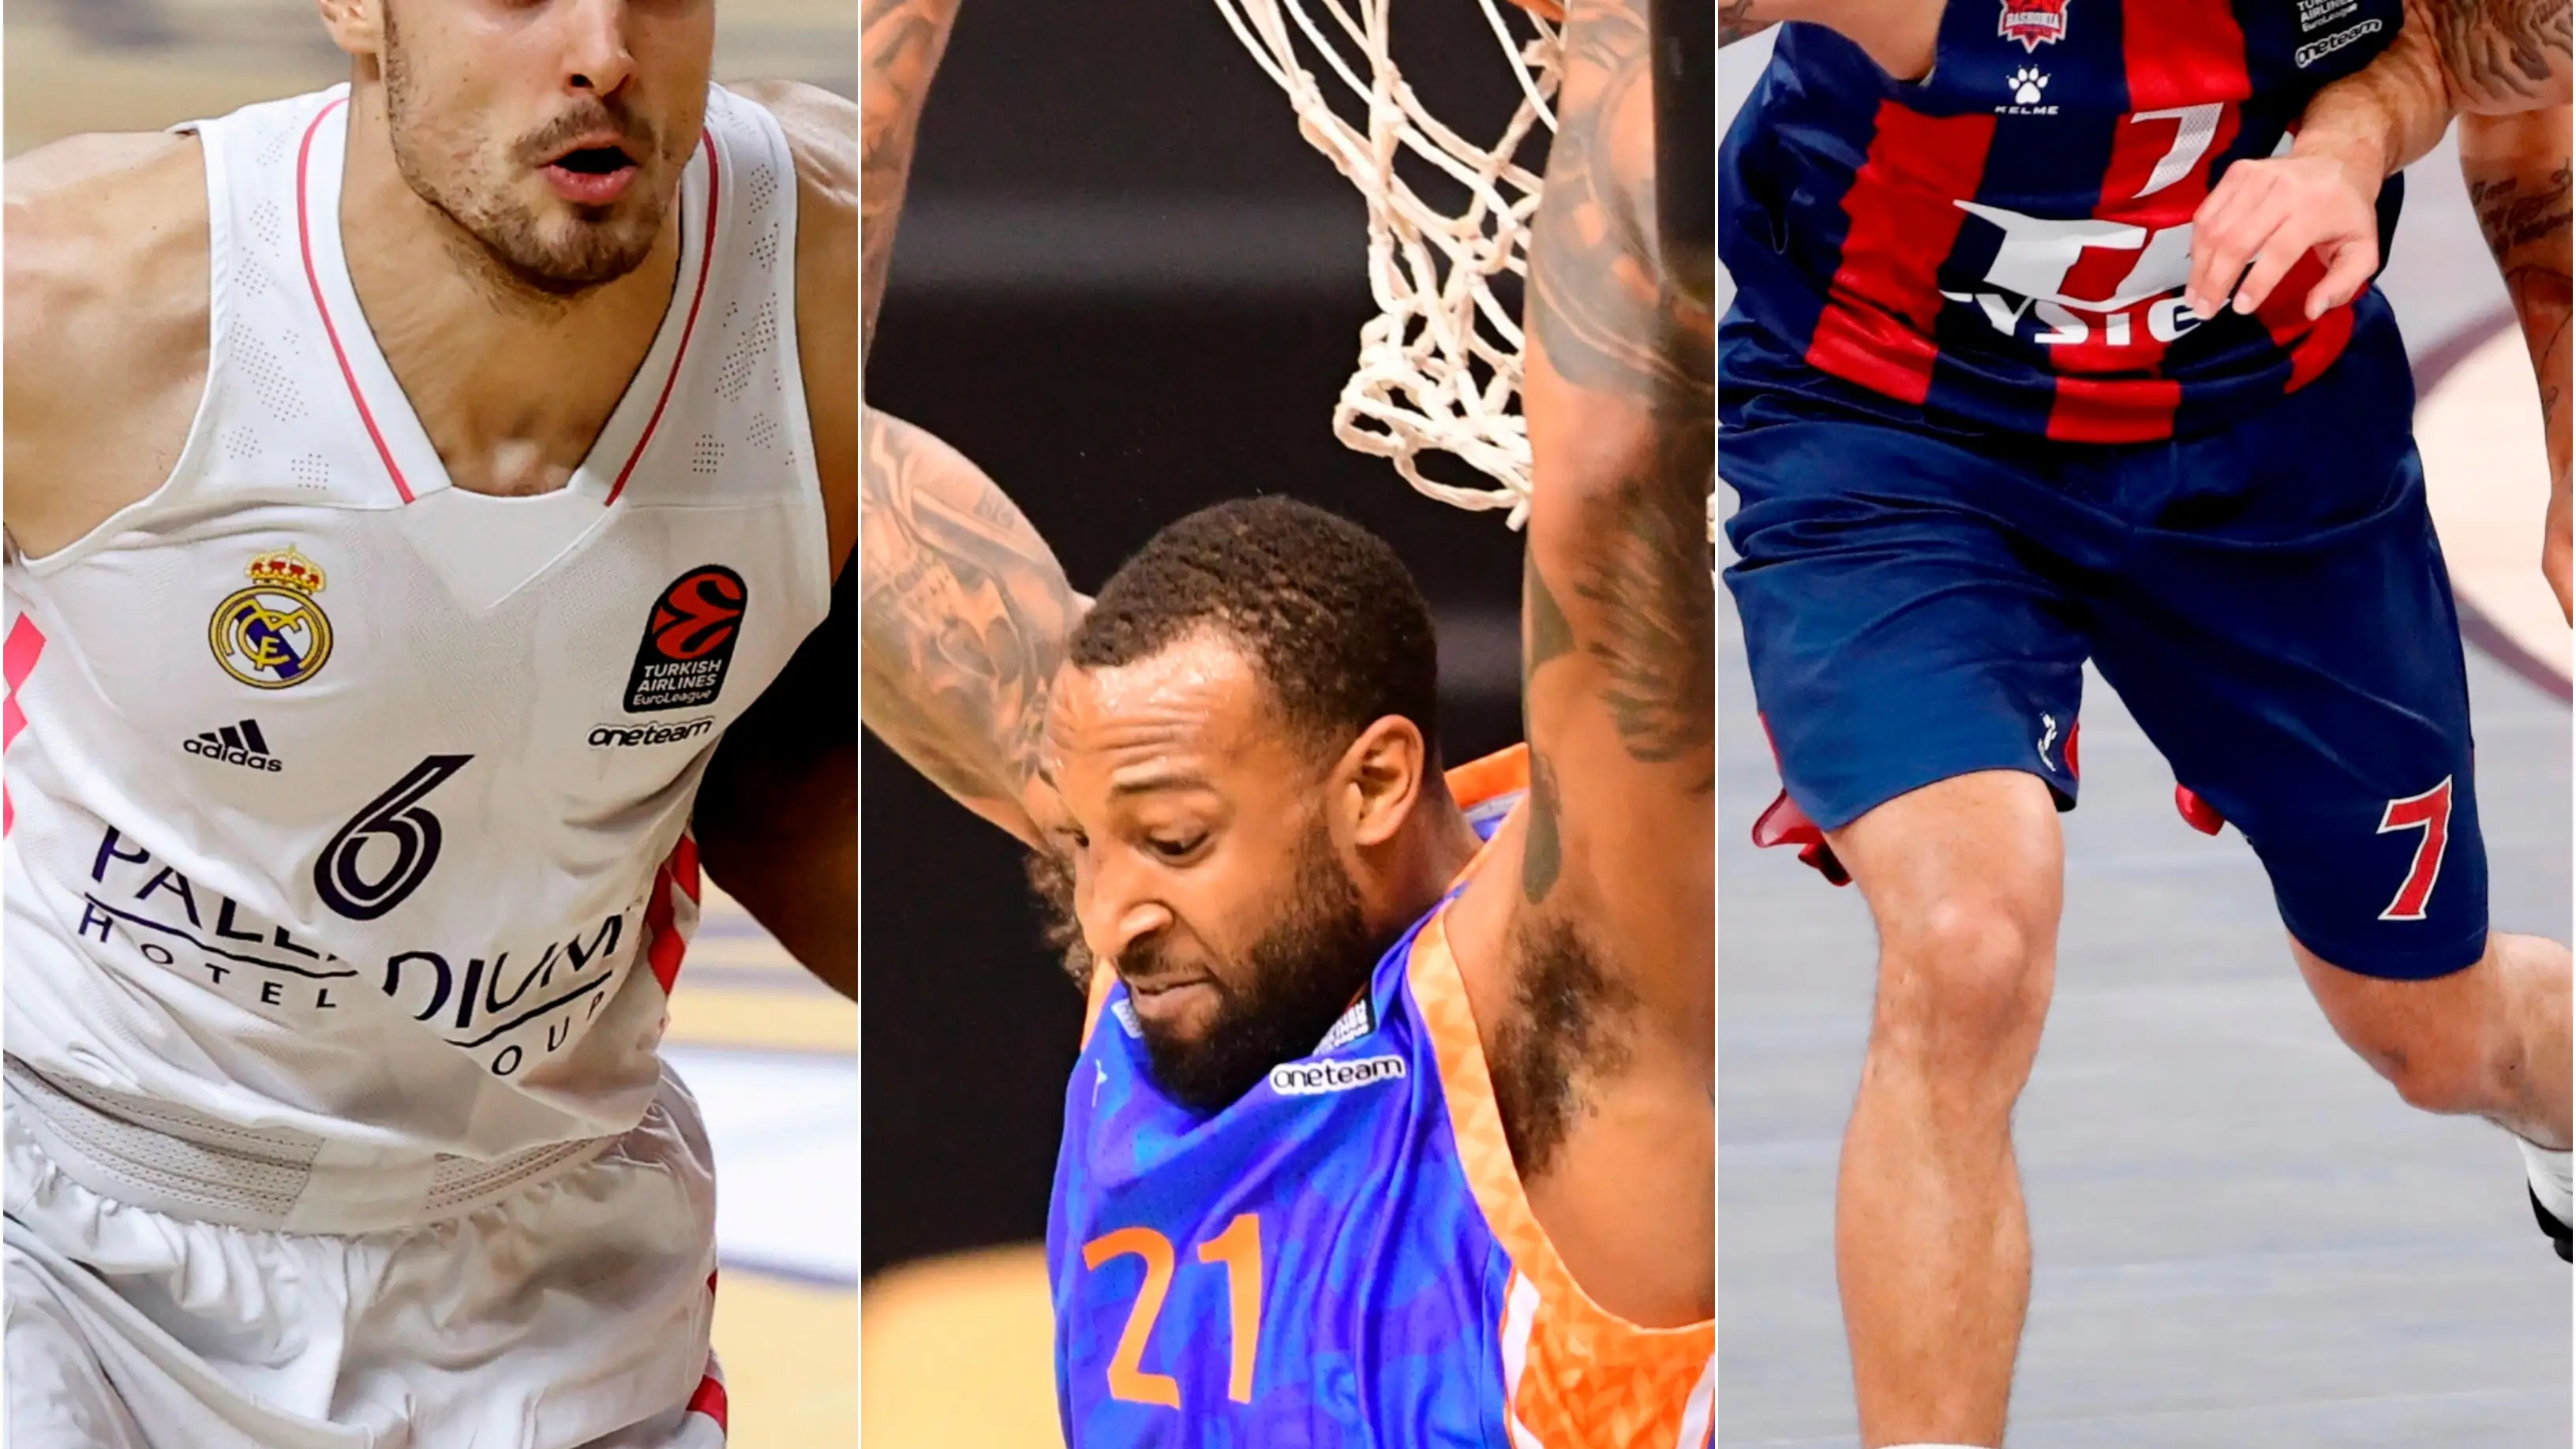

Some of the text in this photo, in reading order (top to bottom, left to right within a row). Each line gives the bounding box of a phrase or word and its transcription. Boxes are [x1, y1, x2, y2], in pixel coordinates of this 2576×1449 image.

[2296, 20, 2381, 66] oneteam
[1994, 105, 2059, 115] KELME
[2130, 102, 2224, 199] 7
[637, 674, 717, 693] AIRLINES
[644, 659, 722, 678] TURKISH
[632, 690, 712, 706] EuroLeague
[588, 720, 713, 747] oneteam
[182, 738, 283, 773] adidas
[313, 754, 474, 920] 6
[2376, 773, 2452, 921] 7
[78, 901, 605, 1076] HOTEL OUP
[1273, 1058, 1402, 1089] oneteam
[1082, 1213, 1262, 1410] 21
